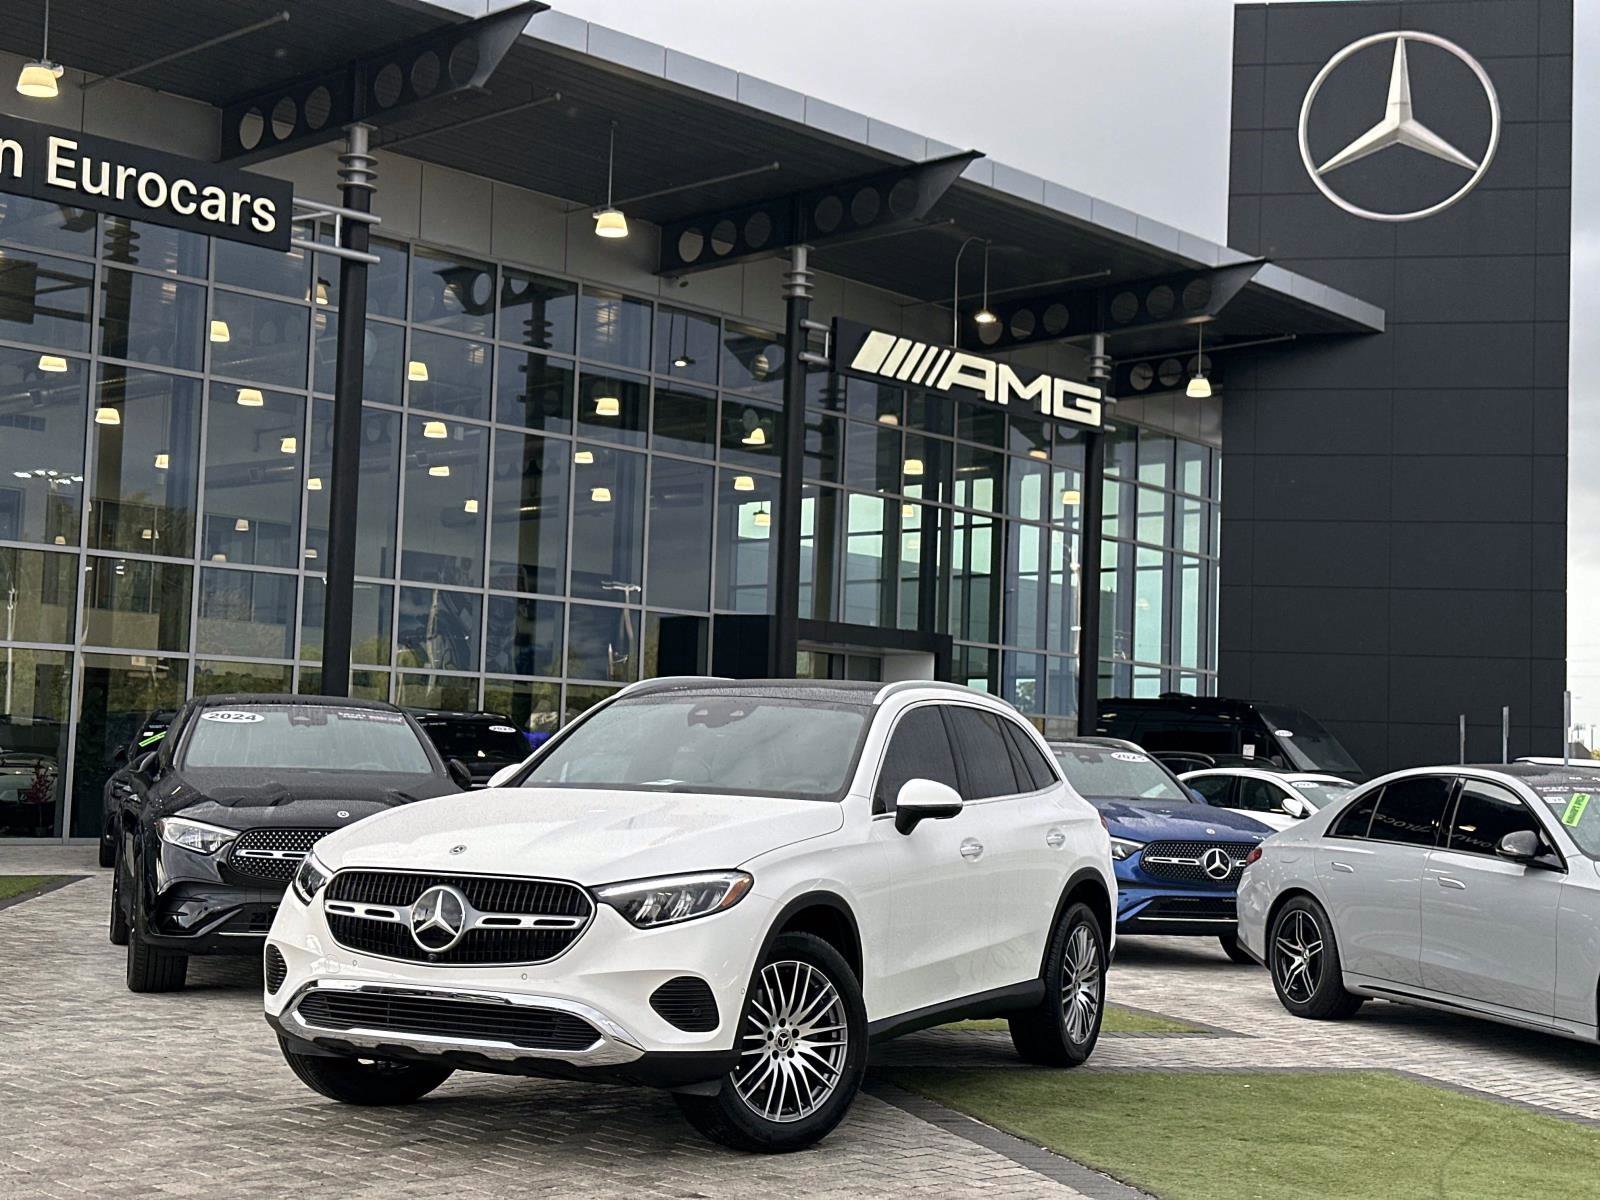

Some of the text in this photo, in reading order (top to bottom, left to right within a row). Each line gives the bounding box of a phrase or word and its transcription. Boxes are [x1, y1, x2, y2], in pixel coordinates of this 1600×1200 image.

[47, 136, 277, 233] Eurocars
[936, 351, 1101, 426] AMG
[208, 712, 257, 721] 2024
